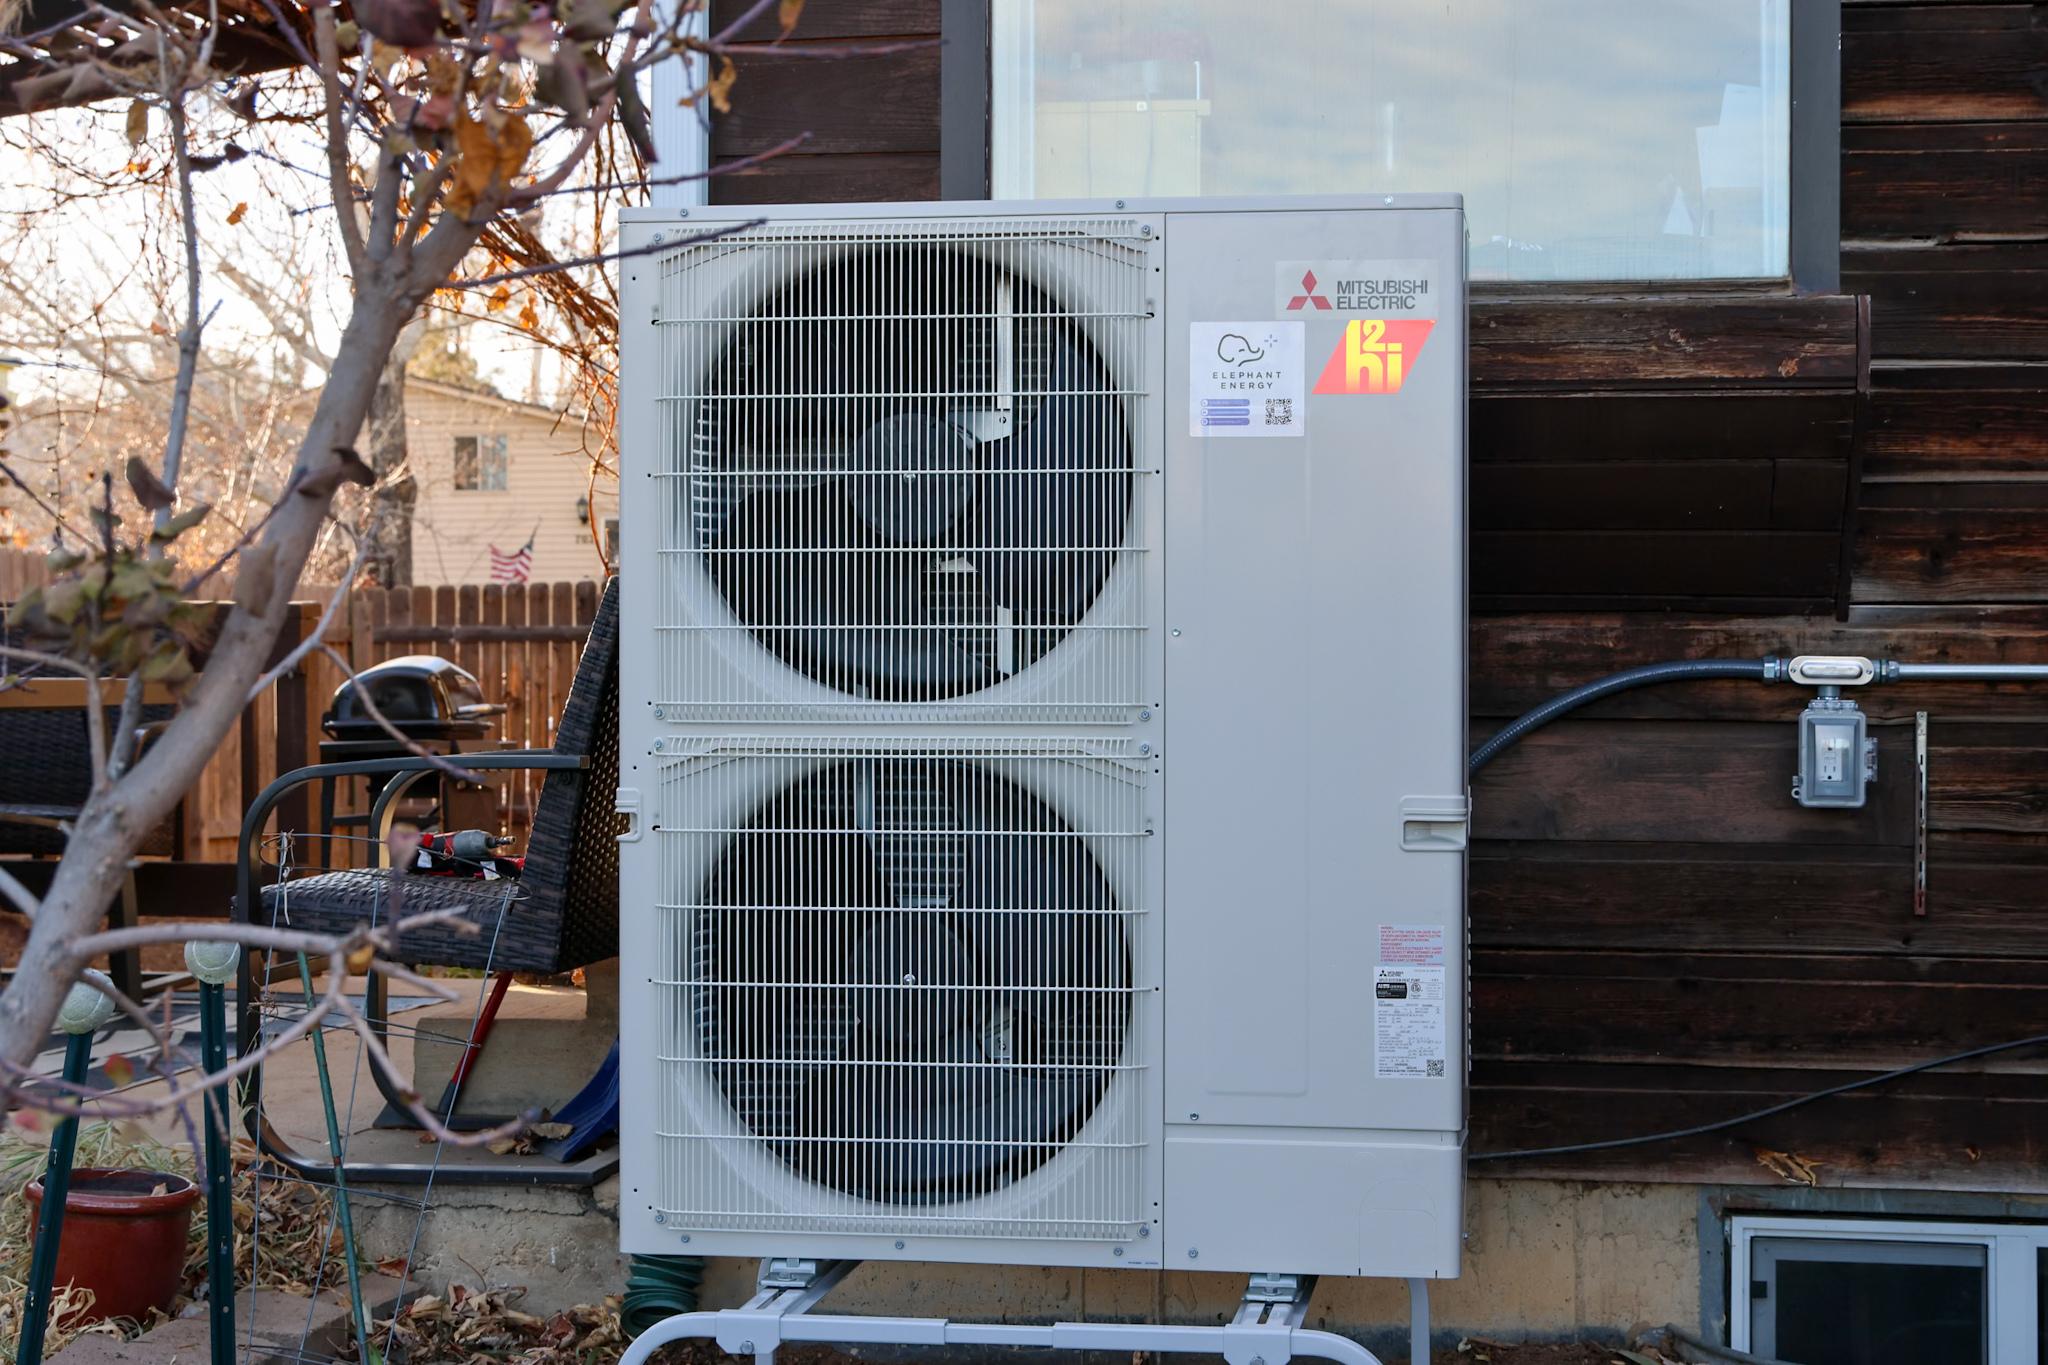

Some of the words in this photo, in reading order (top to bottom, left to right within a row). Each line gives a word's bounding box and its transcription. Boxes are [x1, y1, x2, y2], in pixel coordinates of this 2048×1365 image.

[1337, 280, 1428, 295] MITSUBISHI
[1337, 295, 1416, 310] ELECTRIC
[1212, 371, 1282, 379] ELEPHANT
[1220, 382, 1273, 390] ENERGY
